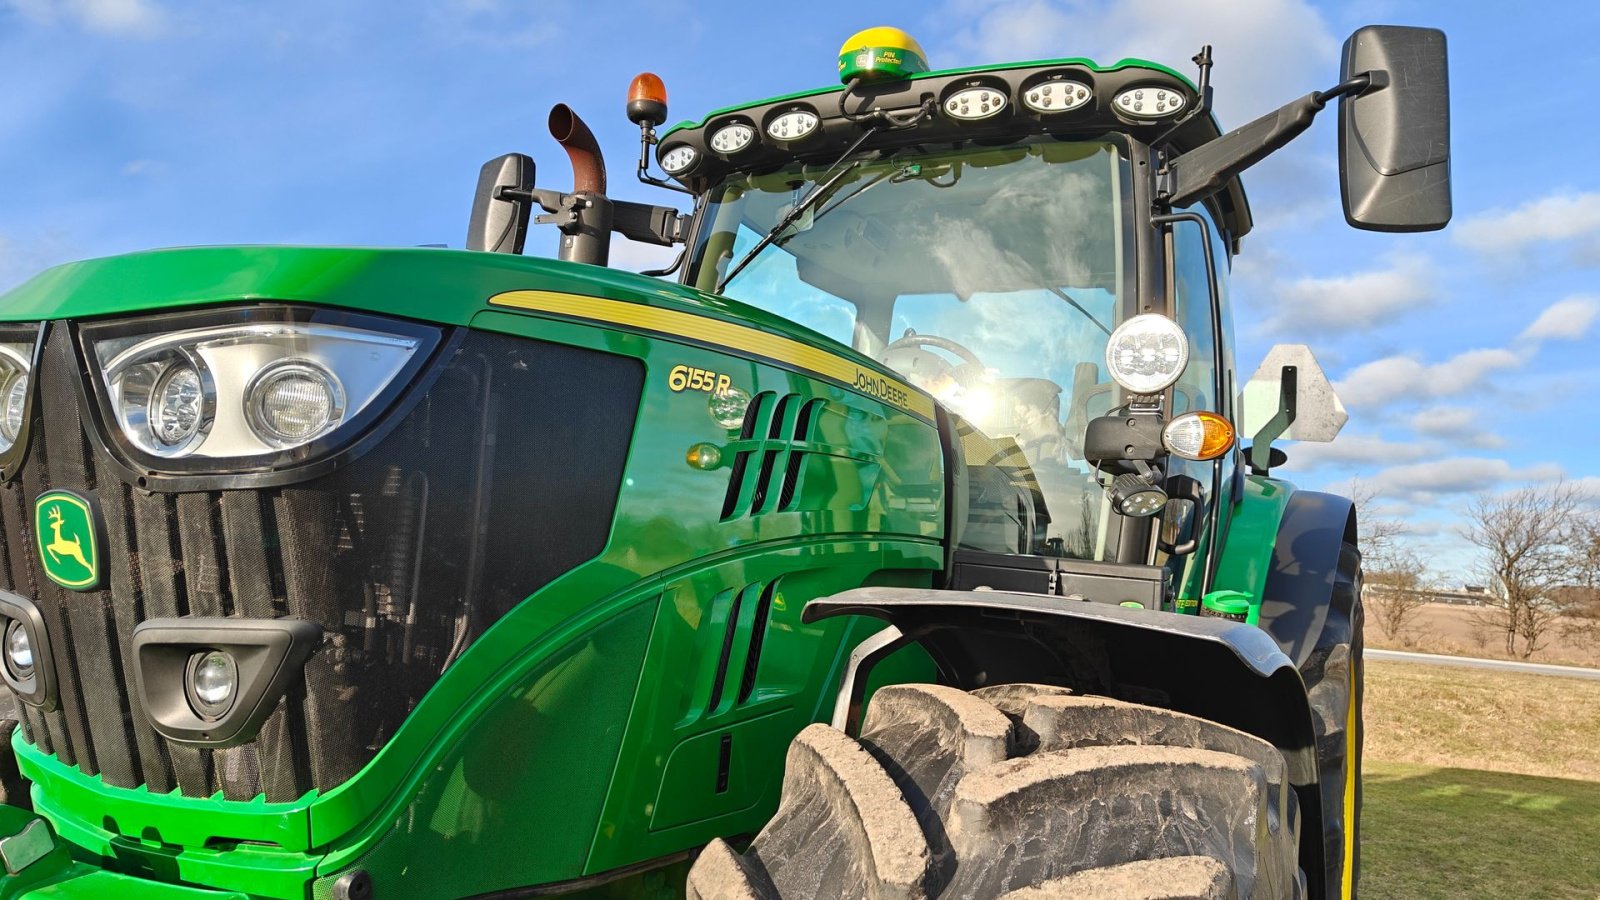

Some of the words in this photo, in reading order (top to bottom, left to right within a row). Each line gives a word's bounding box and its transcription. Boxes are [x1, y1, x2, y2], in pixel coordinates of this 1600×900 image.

[875, 56, 902, 65] Protected
[853, 367, 880, 395] JOHN
[880, 378, 908, 408] DEERE
